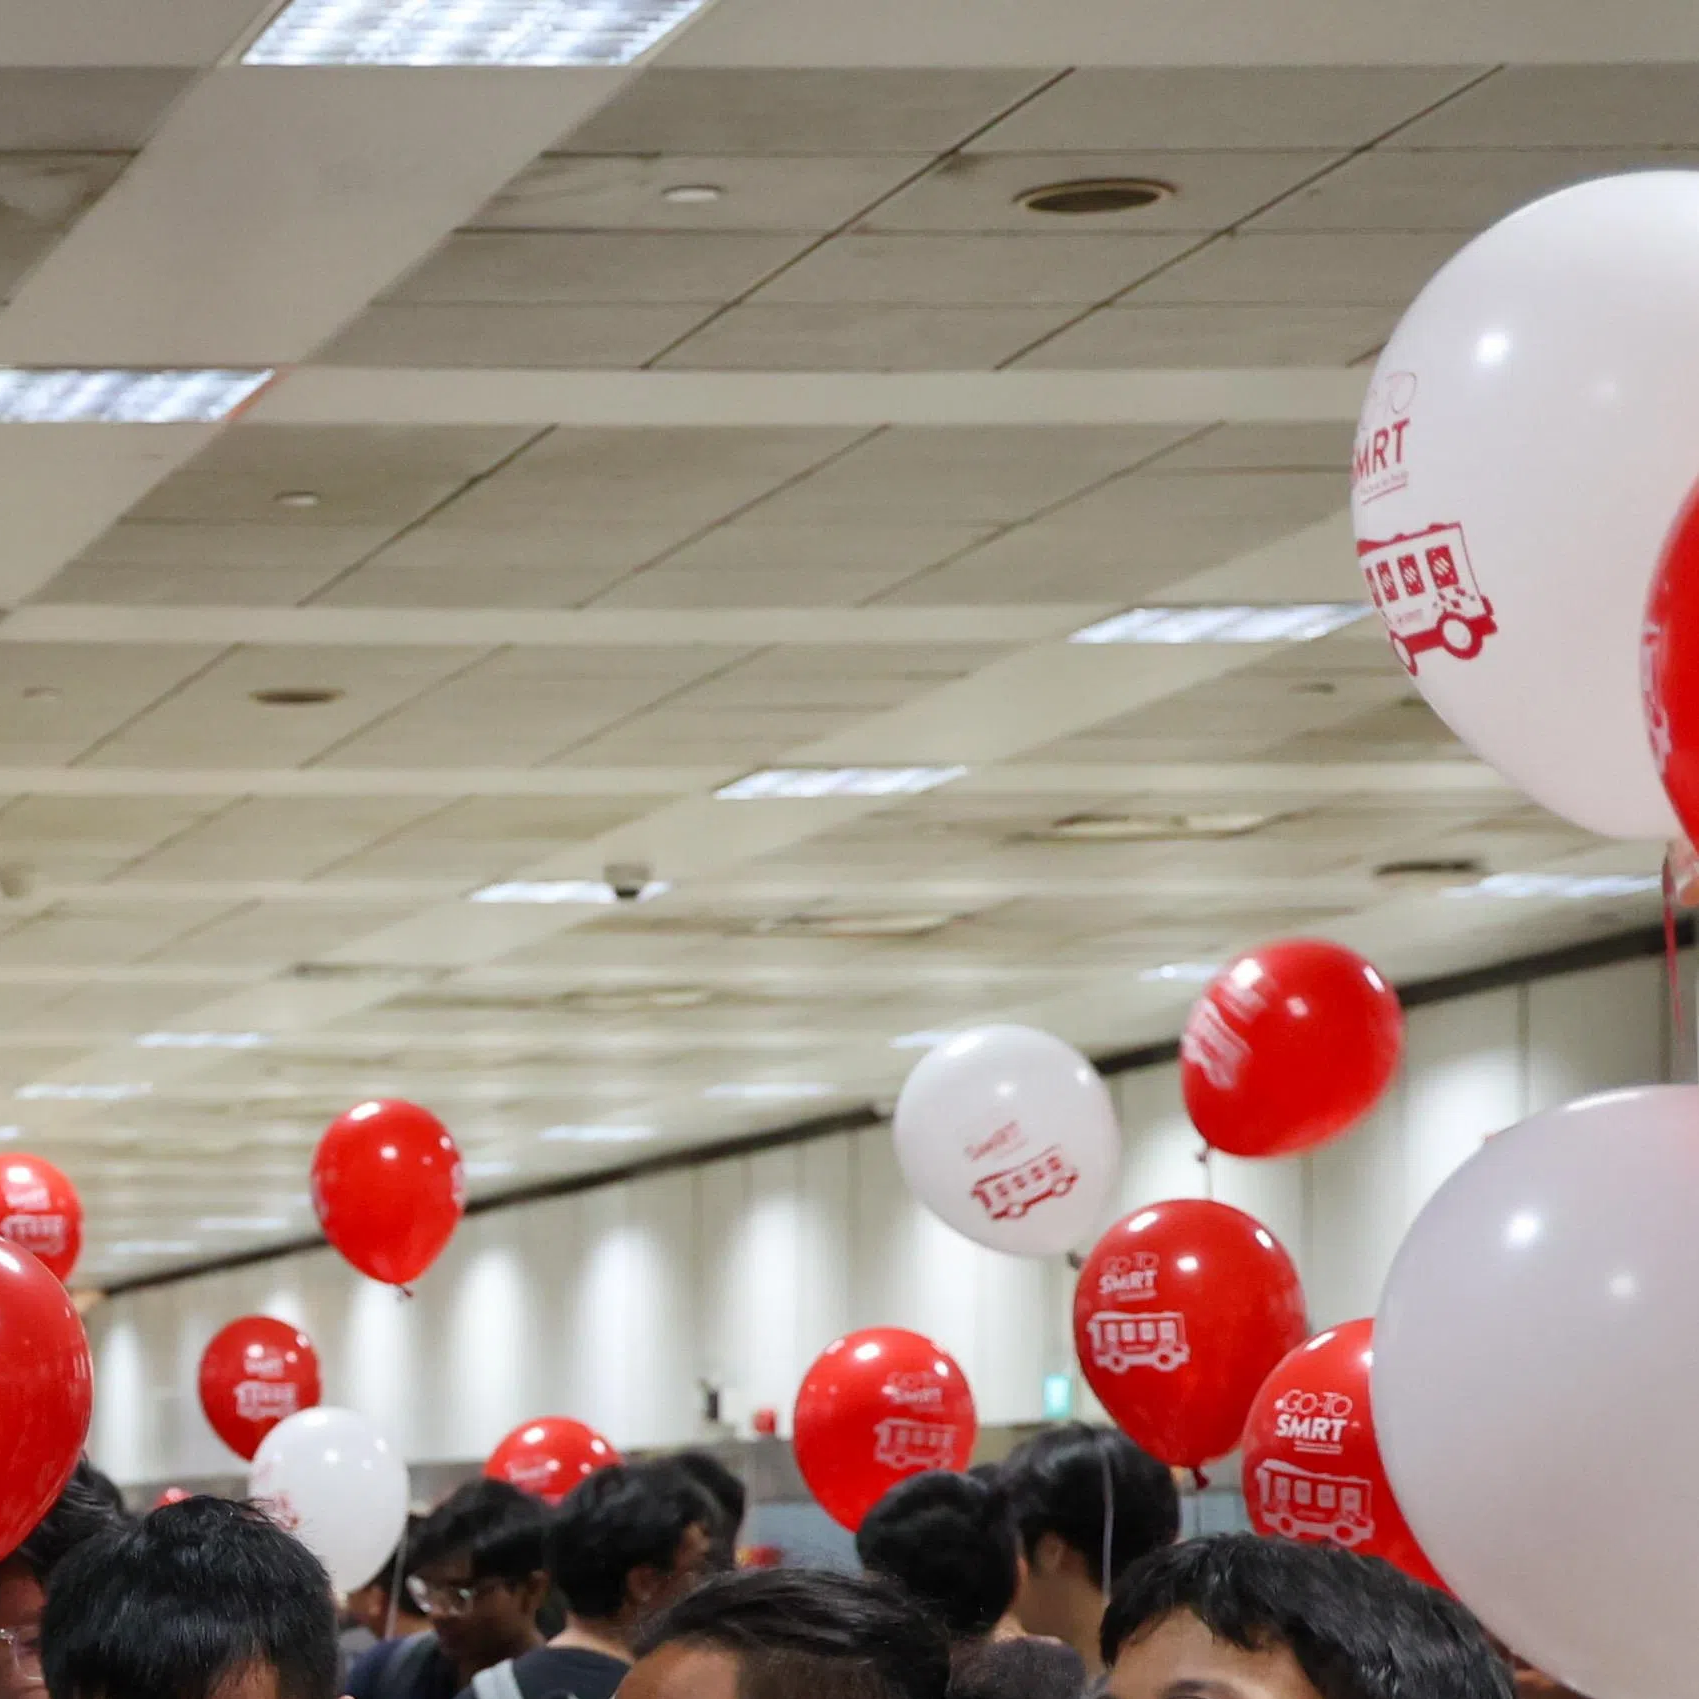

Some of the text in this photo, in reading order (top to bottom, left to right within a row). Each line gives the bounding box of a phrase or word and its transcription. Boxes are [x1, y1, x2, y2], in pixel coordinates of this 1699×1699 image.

[1097, 1269, 1158, 1294] SMRT
[1281, 1388, 1353, 1417] GO-TO
[1275, 1413, 1348, 1441] SMRT
